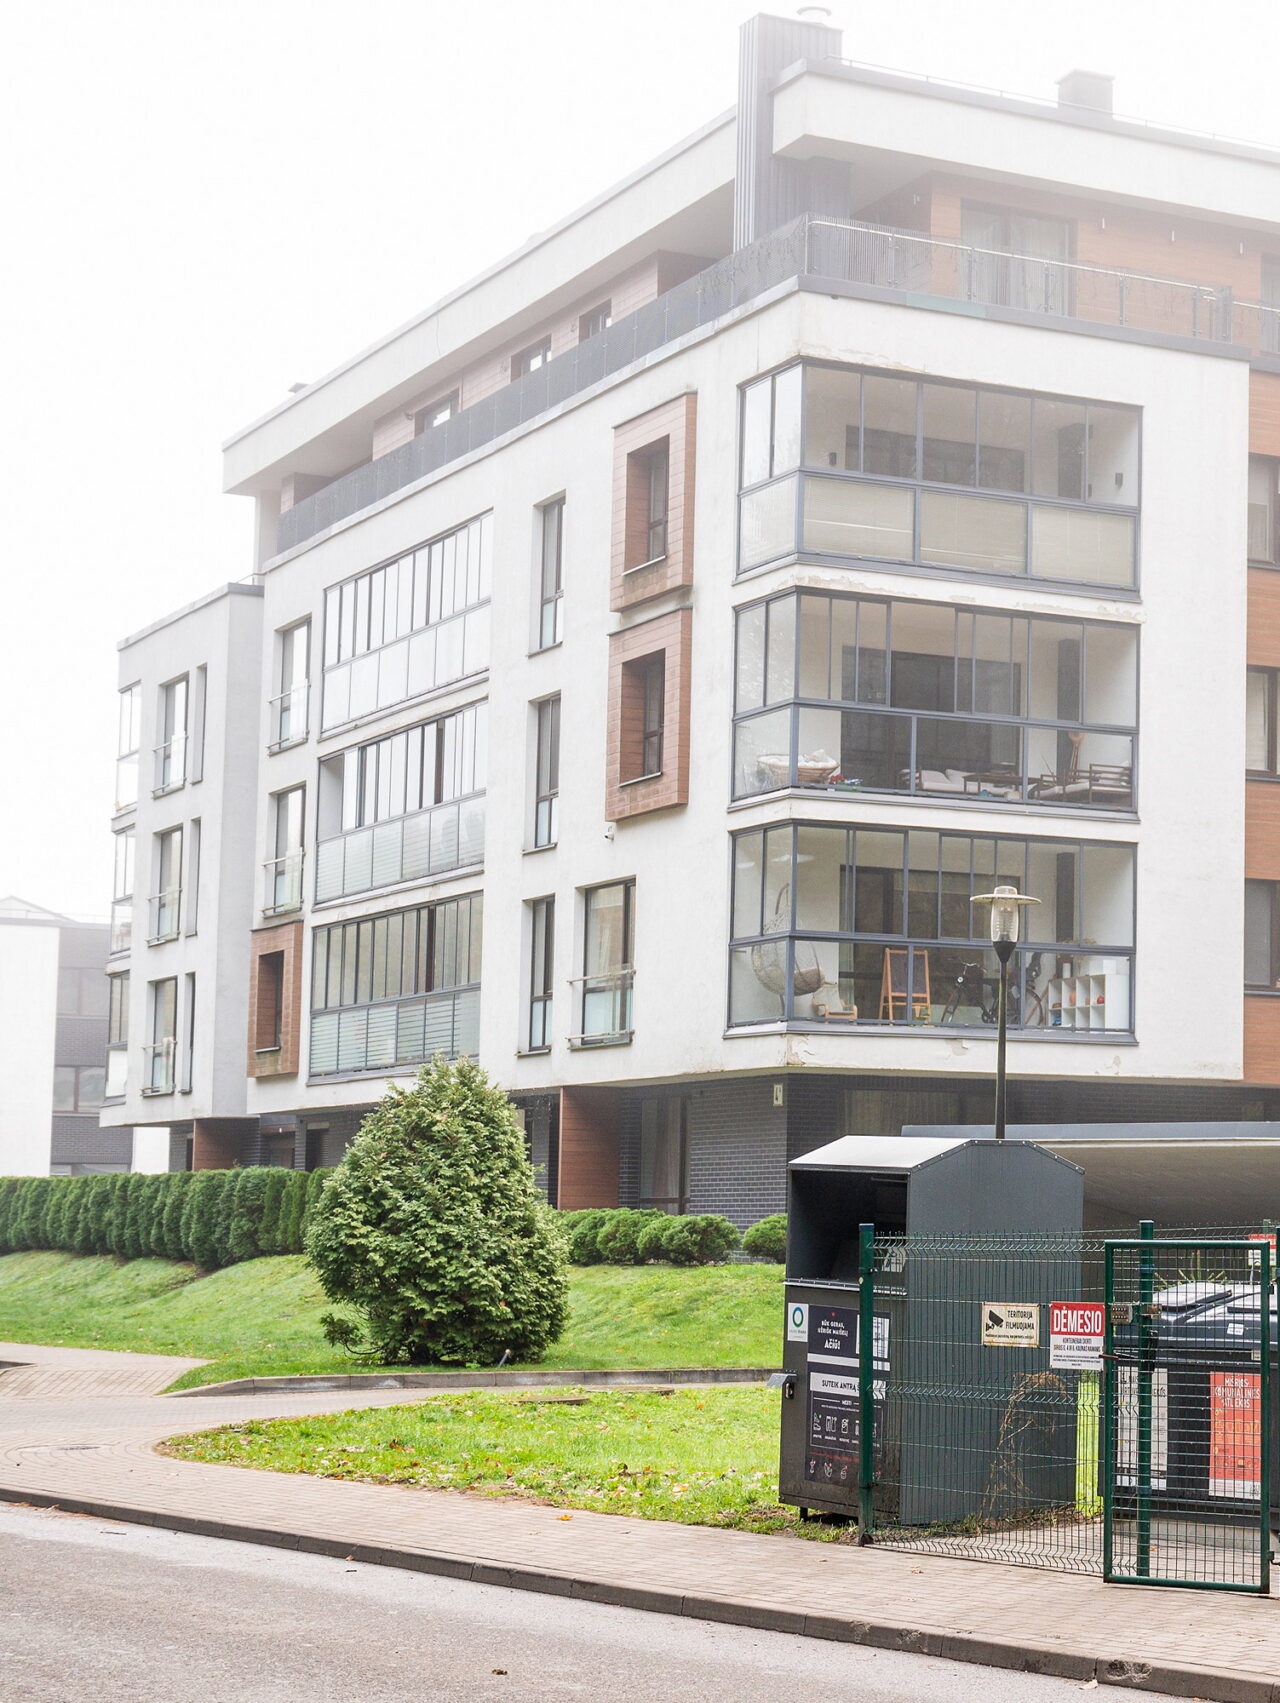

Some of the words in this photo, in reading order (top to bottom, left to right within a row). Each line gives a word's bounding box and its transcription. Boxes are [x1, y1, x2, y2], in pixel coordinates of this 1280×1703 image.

[1007, 1310, 1033, 1319] TERITORIJA
[1053, 1306, 1102, 1333] DĖMESIO
[1005, 1321, 1035, 1331] FILMUOJAMA
[824, 1338, 841, 1350] AČIŪ!
[822, 1379, 839, 1389] SUTEIK
